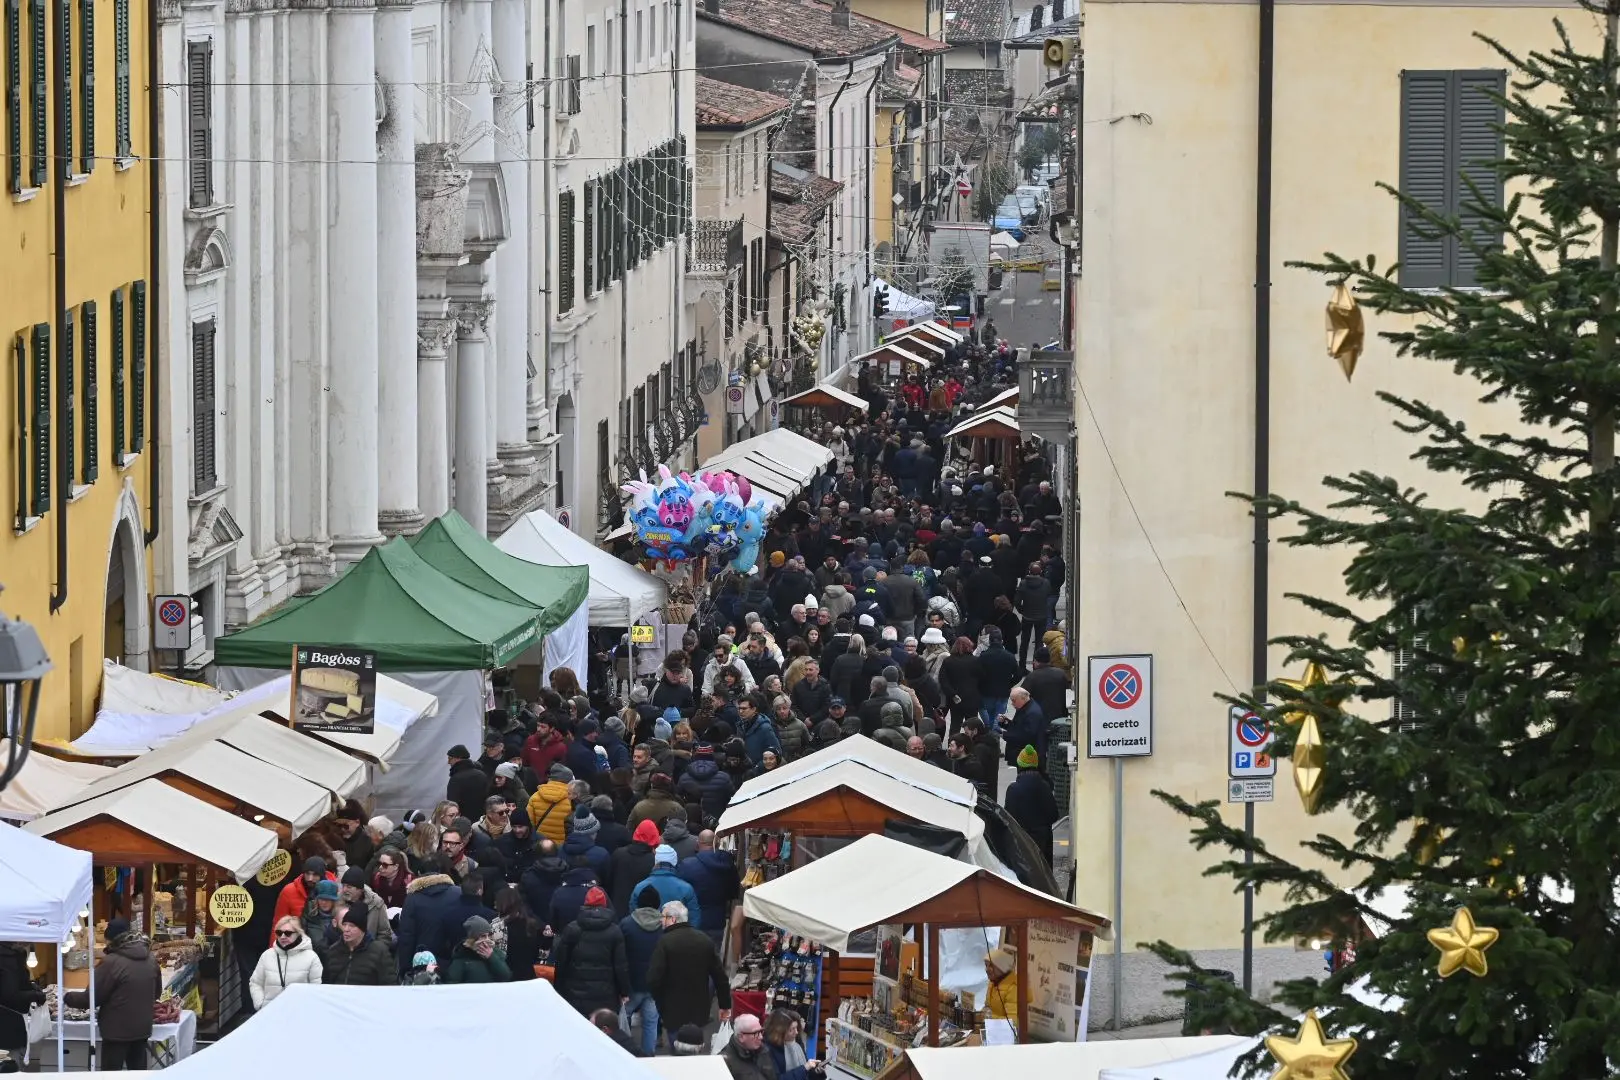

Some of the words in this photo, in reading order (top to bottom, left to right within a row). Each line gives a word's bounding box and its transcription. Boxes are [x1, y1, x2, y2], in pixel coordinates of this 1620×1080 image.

[311, 652, 361, 666] Bagòss
[1102, 720, 1139, 729] eccetto
[1095, 737, 1147, 747] autorizzati
[1238, 754, 1248, 767] P
[214, 893, 248, 902] OFFERTA
